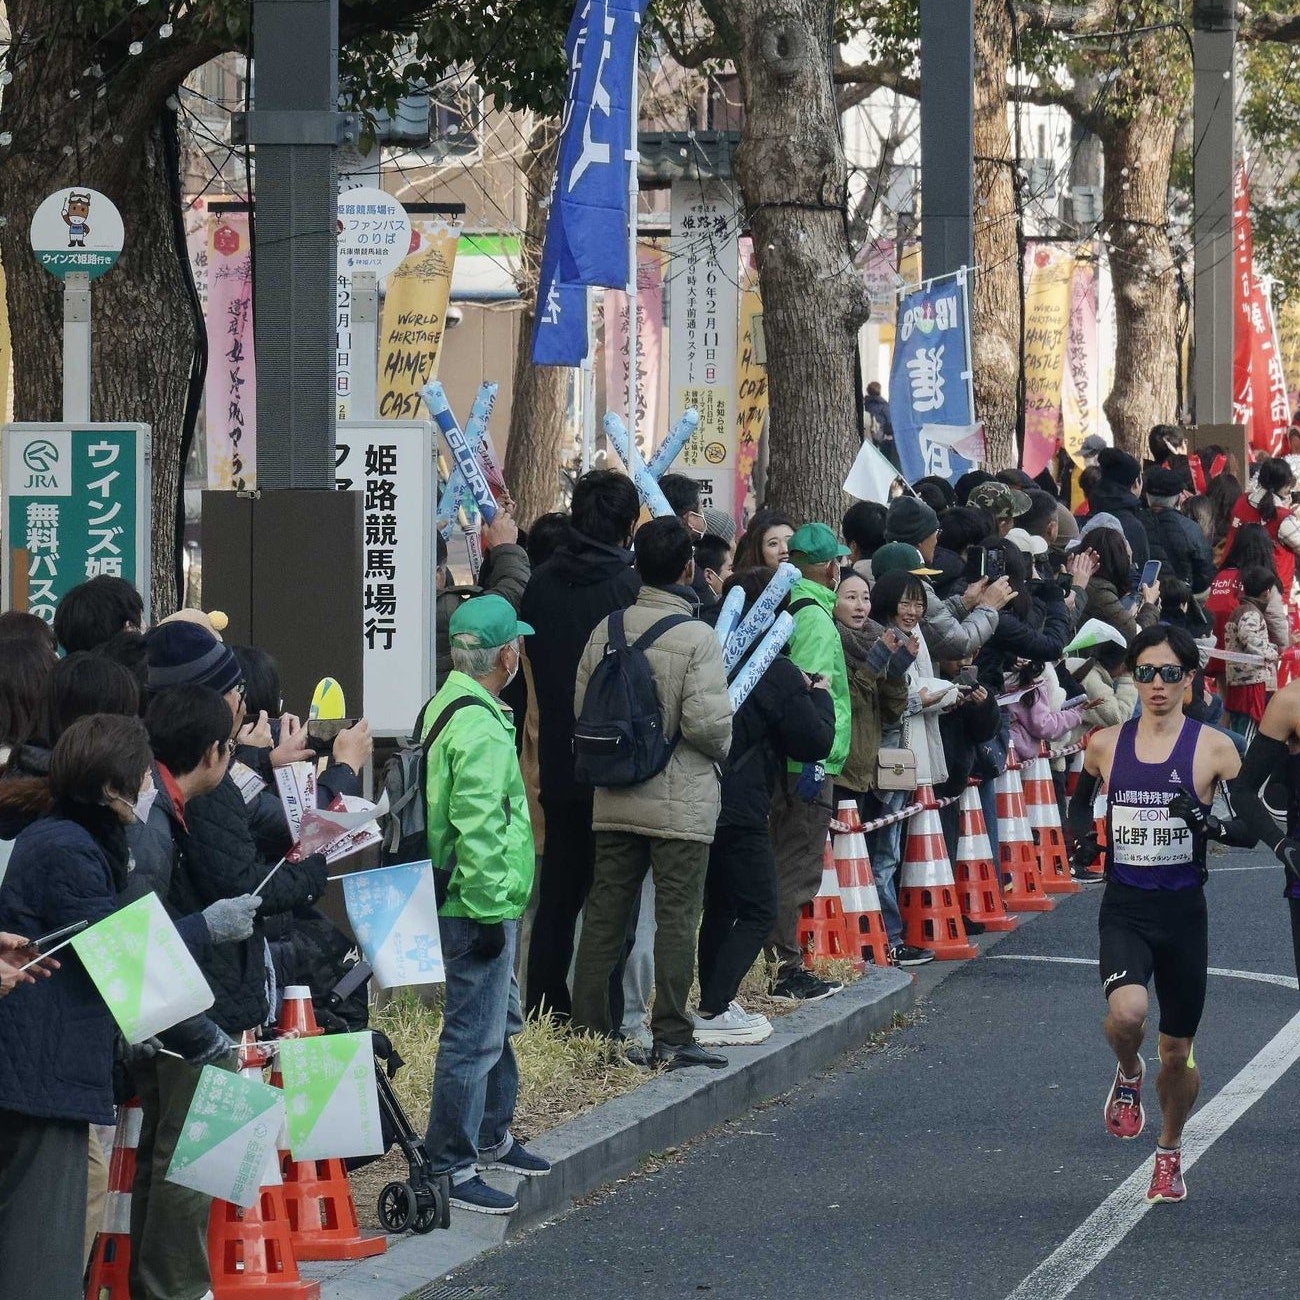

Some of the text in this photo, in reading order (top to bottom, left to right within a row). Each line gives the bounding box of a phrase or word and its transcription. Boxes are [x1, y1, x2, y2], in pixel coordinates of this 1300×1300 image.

[349, 220, 405, 231] ファンバス
[357, 233, 396, 244] のりば
[42, 253, 112, 265] ウインズ姫路行き
[340, 248, 389, 256] 兵庫県競馬組合
[397, 311, 439, 326] WORLD
[388, 330, 442, 345] HERITAGE
[716, 400, 726, 434] お知らせ
[446, 428, 498, 510] GLORY
[24, 475, 59, 489] JRA
[84, 440, 123, 578] ウインズ姫
[364, 444, 398, 651] 姫路競馬場行
[25, 502, 61, 626] 無料バスの
[1115, 826, 1190, 846] 北野 開平
